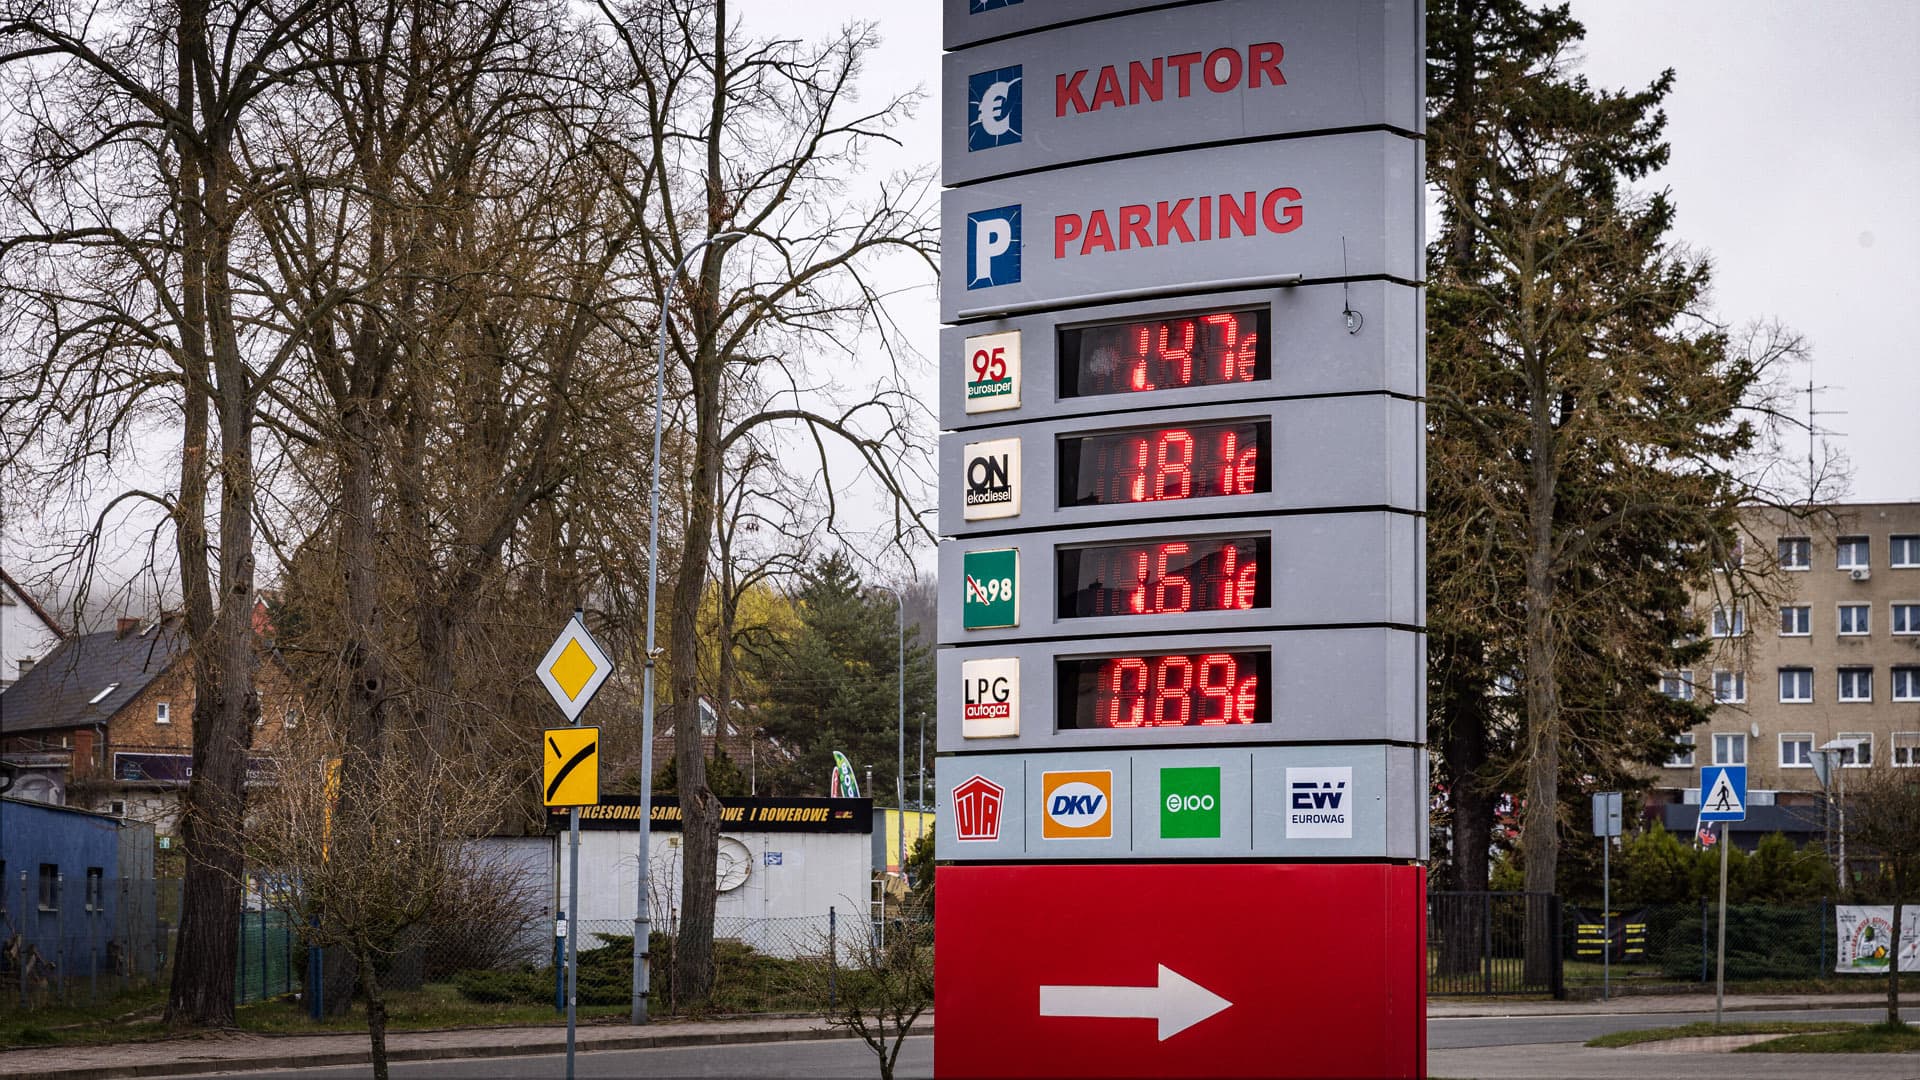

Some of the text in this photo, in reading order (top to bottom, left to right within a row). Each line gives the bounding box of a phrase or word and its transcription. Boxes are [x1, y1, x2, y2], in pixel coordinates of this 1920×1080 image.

[1055, 41, 1288, 118] KANTOR
[1054, 186, 1304, 260] PARKING
[976, 218, 1012, 279] P
[972, 347, 1007, 384] 95
[968, 382, 1012, 397] eurosuper
[967, 453, 1009, 491] ON
[967, 486, 1011, 504] ekodiesel
[964, 676, 1010, 704] LPG
[967, 704, 1008, 718] autogaz
[956, 780, 1001, 836] UTA
[1051, 794, 1104, 816] DKV
[1292, 782, 1346, 809] EW
[758, 807, 830, 822] ROWEROWE
[1292, 814, 1345, 824] EUROWAG
